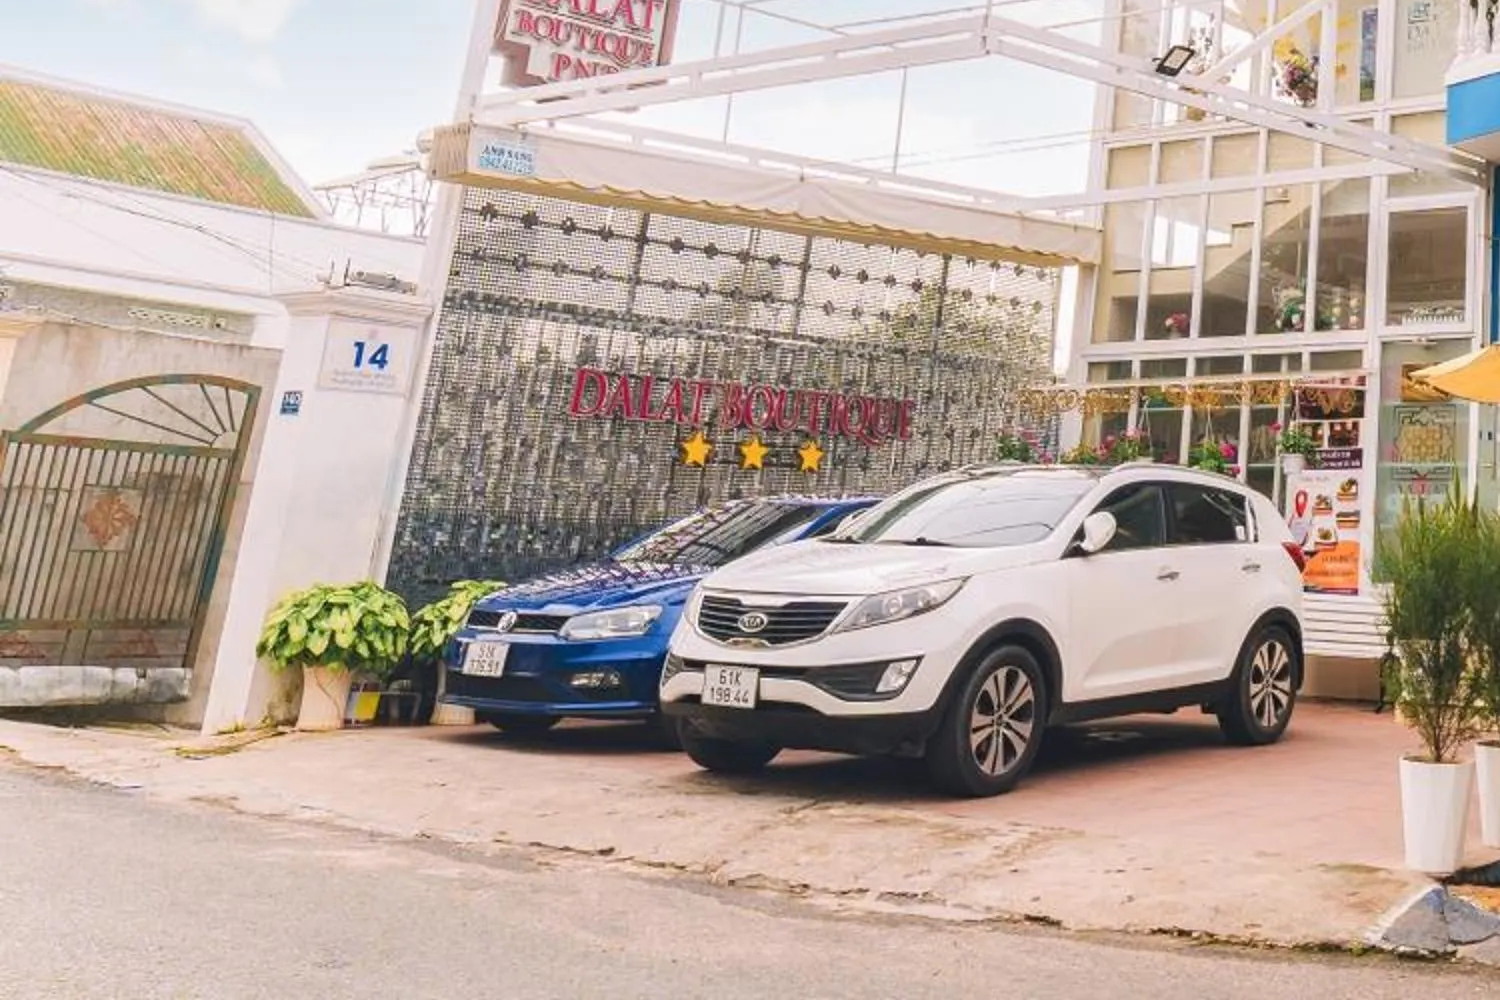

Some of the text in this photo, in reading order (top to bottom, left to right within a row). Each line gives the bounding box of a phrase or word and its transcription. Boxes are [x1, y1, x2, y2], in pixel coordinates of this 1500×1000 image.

[513, 9, 656, 67] BOUTIQUE
[353, 341, 389, 369] 14
[569, 367, 712, 426] DALAT
[719, 669, 742, 686] 61K
[710, 686, 749, 704] 198.44
